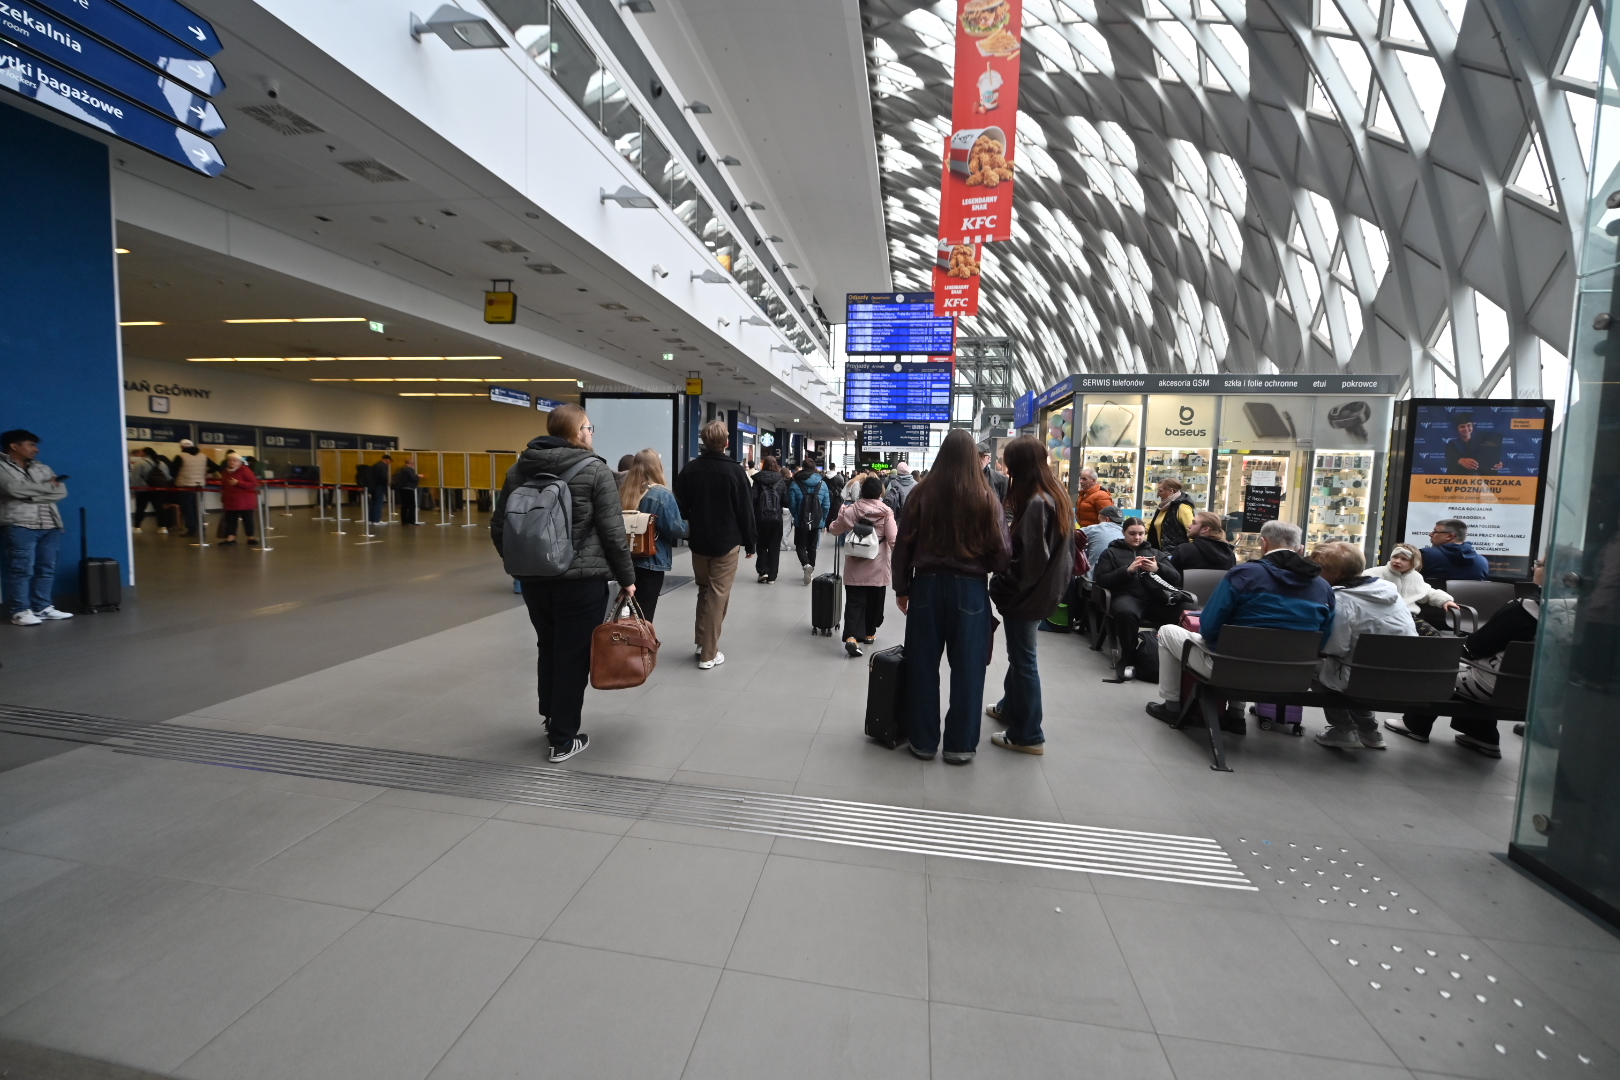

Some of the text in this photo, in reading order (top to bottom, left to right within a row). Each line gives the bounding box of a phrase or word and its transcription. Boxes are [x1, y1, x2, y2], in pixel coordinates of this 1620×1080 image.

[2, 19, 30, 37] room
[6, 69, 37, 89] lockers
[37, 67, 124, 119] bagażowe
[962, 195, 998, 205] LEGENDARNY
[971, 203, 988, 211] SMAK
[960, 215, 998, 231] KFC
[943, 298, 969, 308] KFC
[1082, 379, 1145, 387] SERWIS telefonów
[1158, 379, 1210, 387] akcesoria GSM
[1341, 380, 1378, 389] pokrowce
[154, 384, 212, 399] GŁÓWNY
[1165, 428, 1206, 437] baseus
[775, 449, 782, 458] 3
